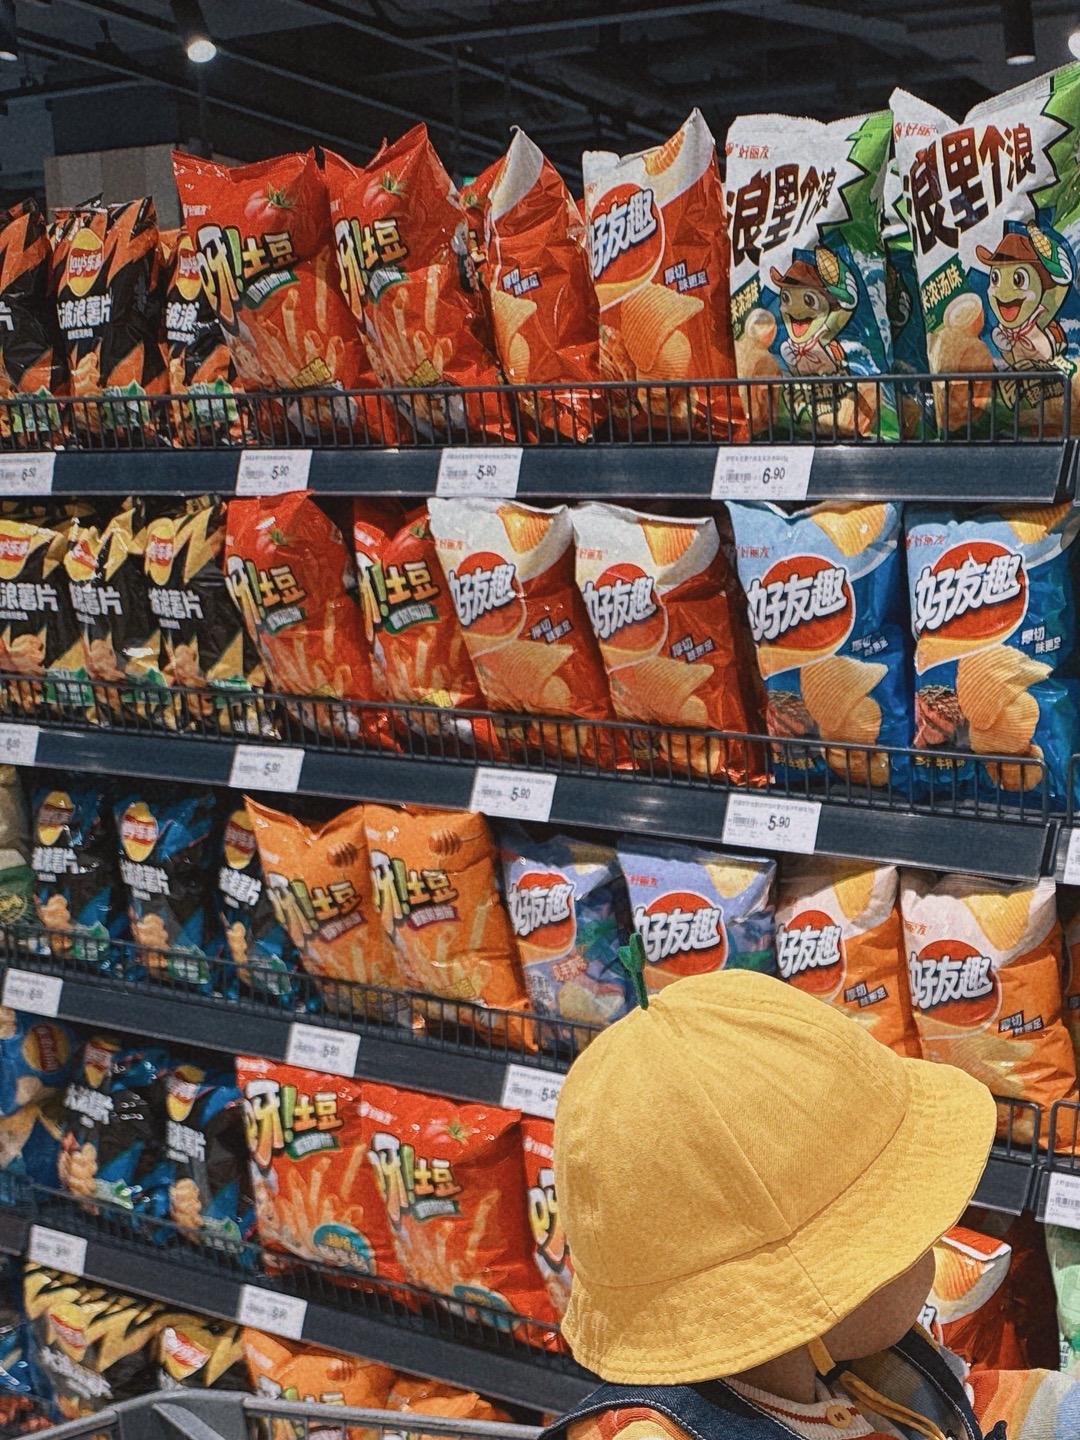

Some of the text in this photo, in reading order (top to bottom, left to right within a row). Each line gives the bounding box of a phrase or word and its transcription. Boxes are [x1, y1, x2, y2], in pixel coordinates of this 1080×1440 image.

[727, 164, 836, 266] 浪里个浪
[904, 123, 1036, 254] 浪里个浪
[664, 262, 686, 285] 厚切
[476, 465, 497, 481] 5.90
[762, 466, 786, 485] 6.90
[450, 563, 516, 626] 好友趣
[583, 576, 657, 640] 好友趣
[748, 566, 847, 641] 好友趣
[914, 554, 1023, 630] 好友趣
[1021, 626, 1045, 645] 厚切
[1035, 636, 1062, 654] 味更足
[768, 815, 791, 831] 5.90
[635, 907, 721, 963] 好友趣
[776, 925, 842, 978] 好友趣
[909, 955, 997, 1010] 好友趣
[999, 1012, 1024, 1031] 厚切
